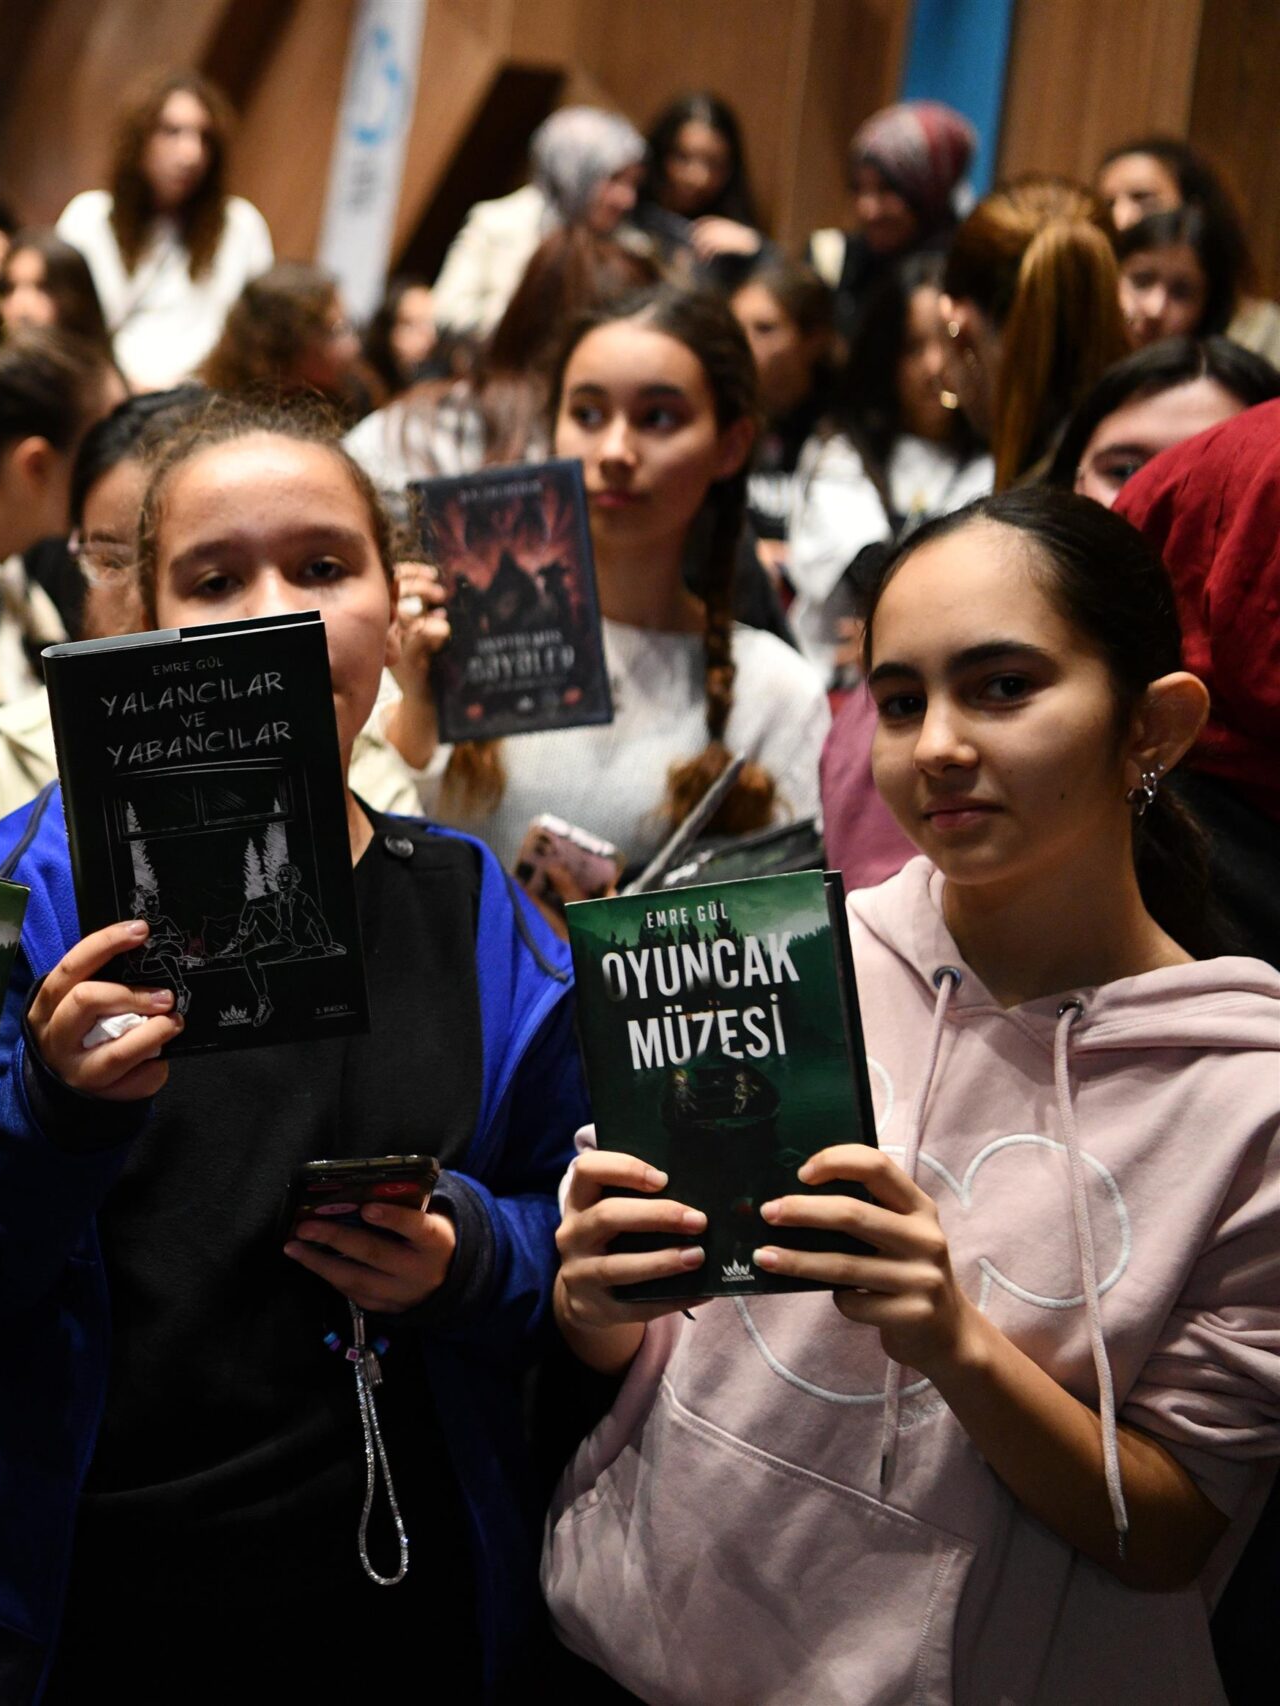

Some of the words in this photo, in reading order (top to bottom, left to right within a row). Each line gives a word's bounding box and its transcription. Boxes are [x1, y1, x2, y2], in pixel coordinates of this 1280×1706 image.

[152, 660, 191, 676] EMRE
[195, 655, 224, 671] GÜL
[100, 671, 285, 718] YALANCILAR
[179, 711, 207, 728] VE
[106, 720, 293, 768] YABANCILAR
[646, 907, 689, 929] EMRE
[697, 901, 729, 922] GÜL
[601, 931, 800, 1002] OYUNCAK
